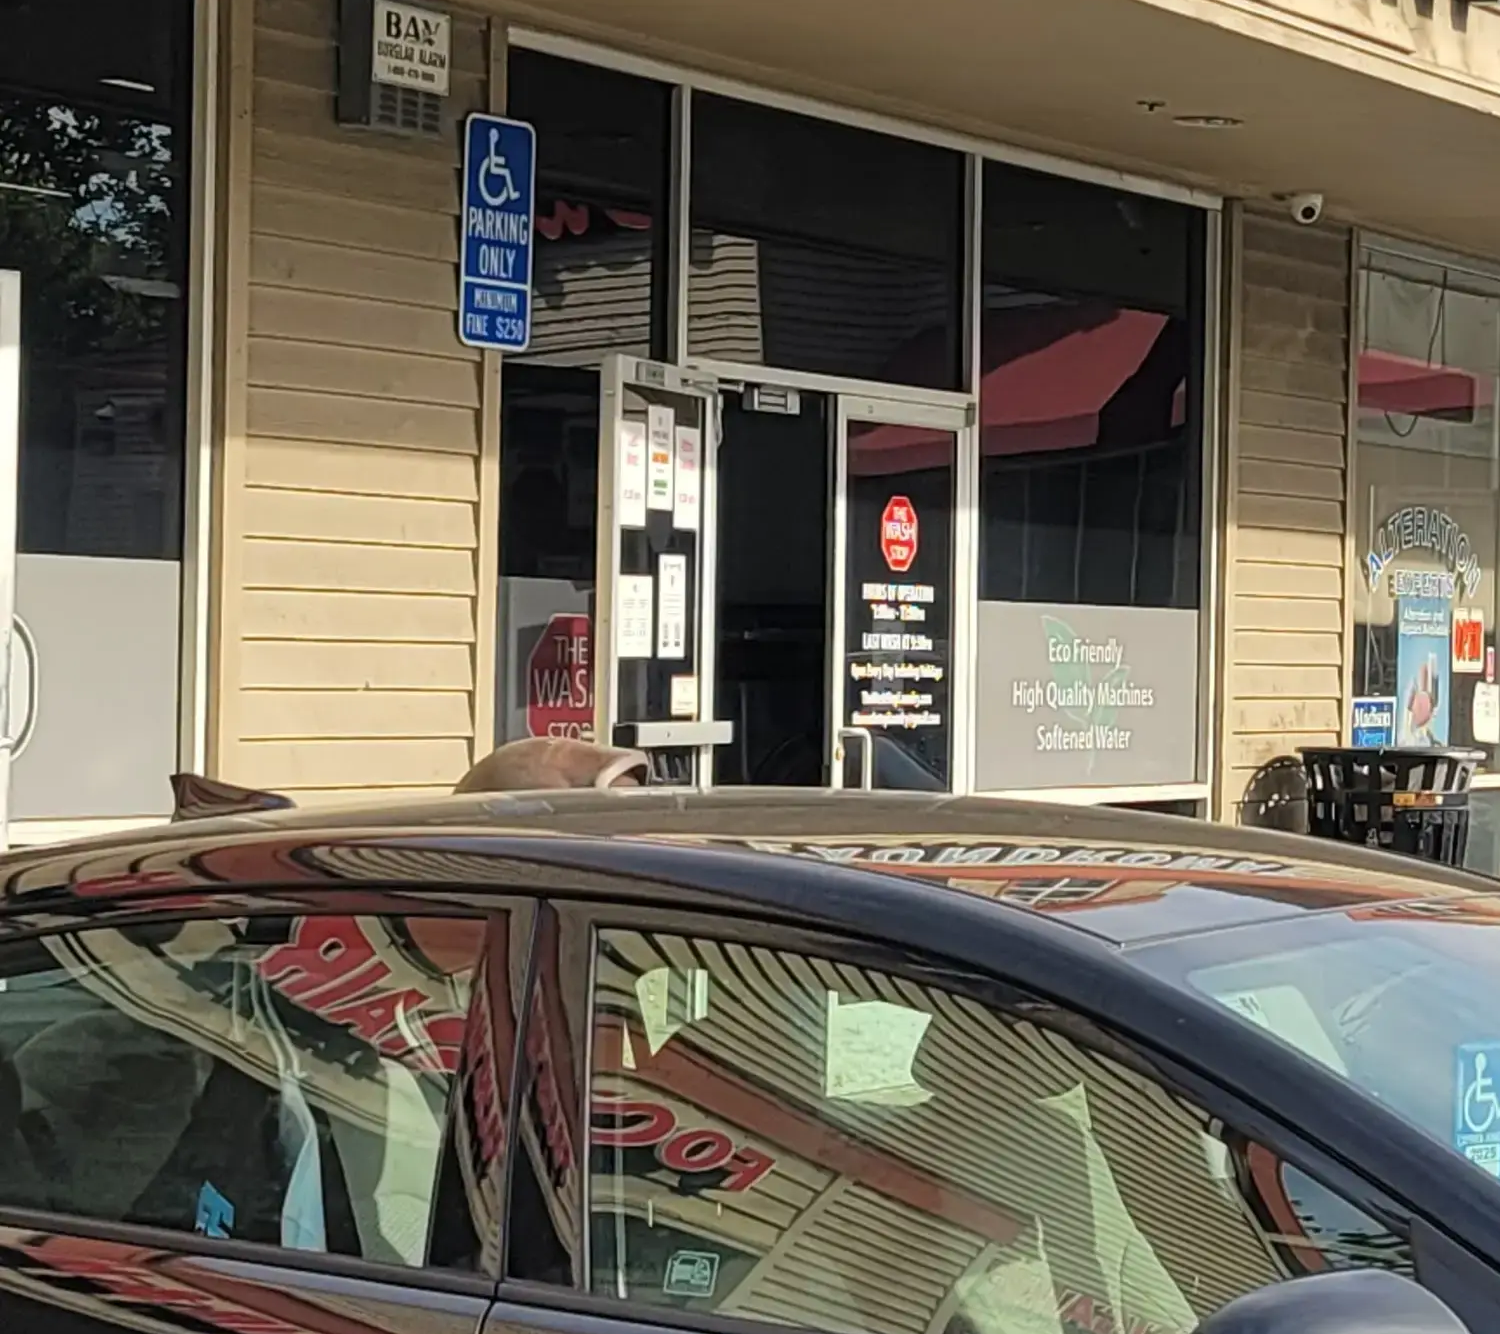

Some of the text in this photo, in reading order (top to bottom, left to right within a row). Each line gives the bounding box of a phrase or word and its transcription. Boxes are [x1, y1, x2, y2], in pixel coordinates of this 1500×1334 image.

[386, 10, 441, 47] BAY
[377, 40, 446, 70] BURGLAR ALARM
[467, 206, 528, 246] PARKING
[478, 244, 517, 279] ONLY
[473, 287, 518, 314] MINIMUM
[465, 312, 525, 341] FINE $250
[1367, 506, 1481, 599] ALTERATION
[552, 635, 589, 665] THE
[1048, 637, 1124, 670] Eco Friendly
[1012, 680, 1154, 717] High Quality Machines
[1036, 724, 1133, 751] Softened Water
